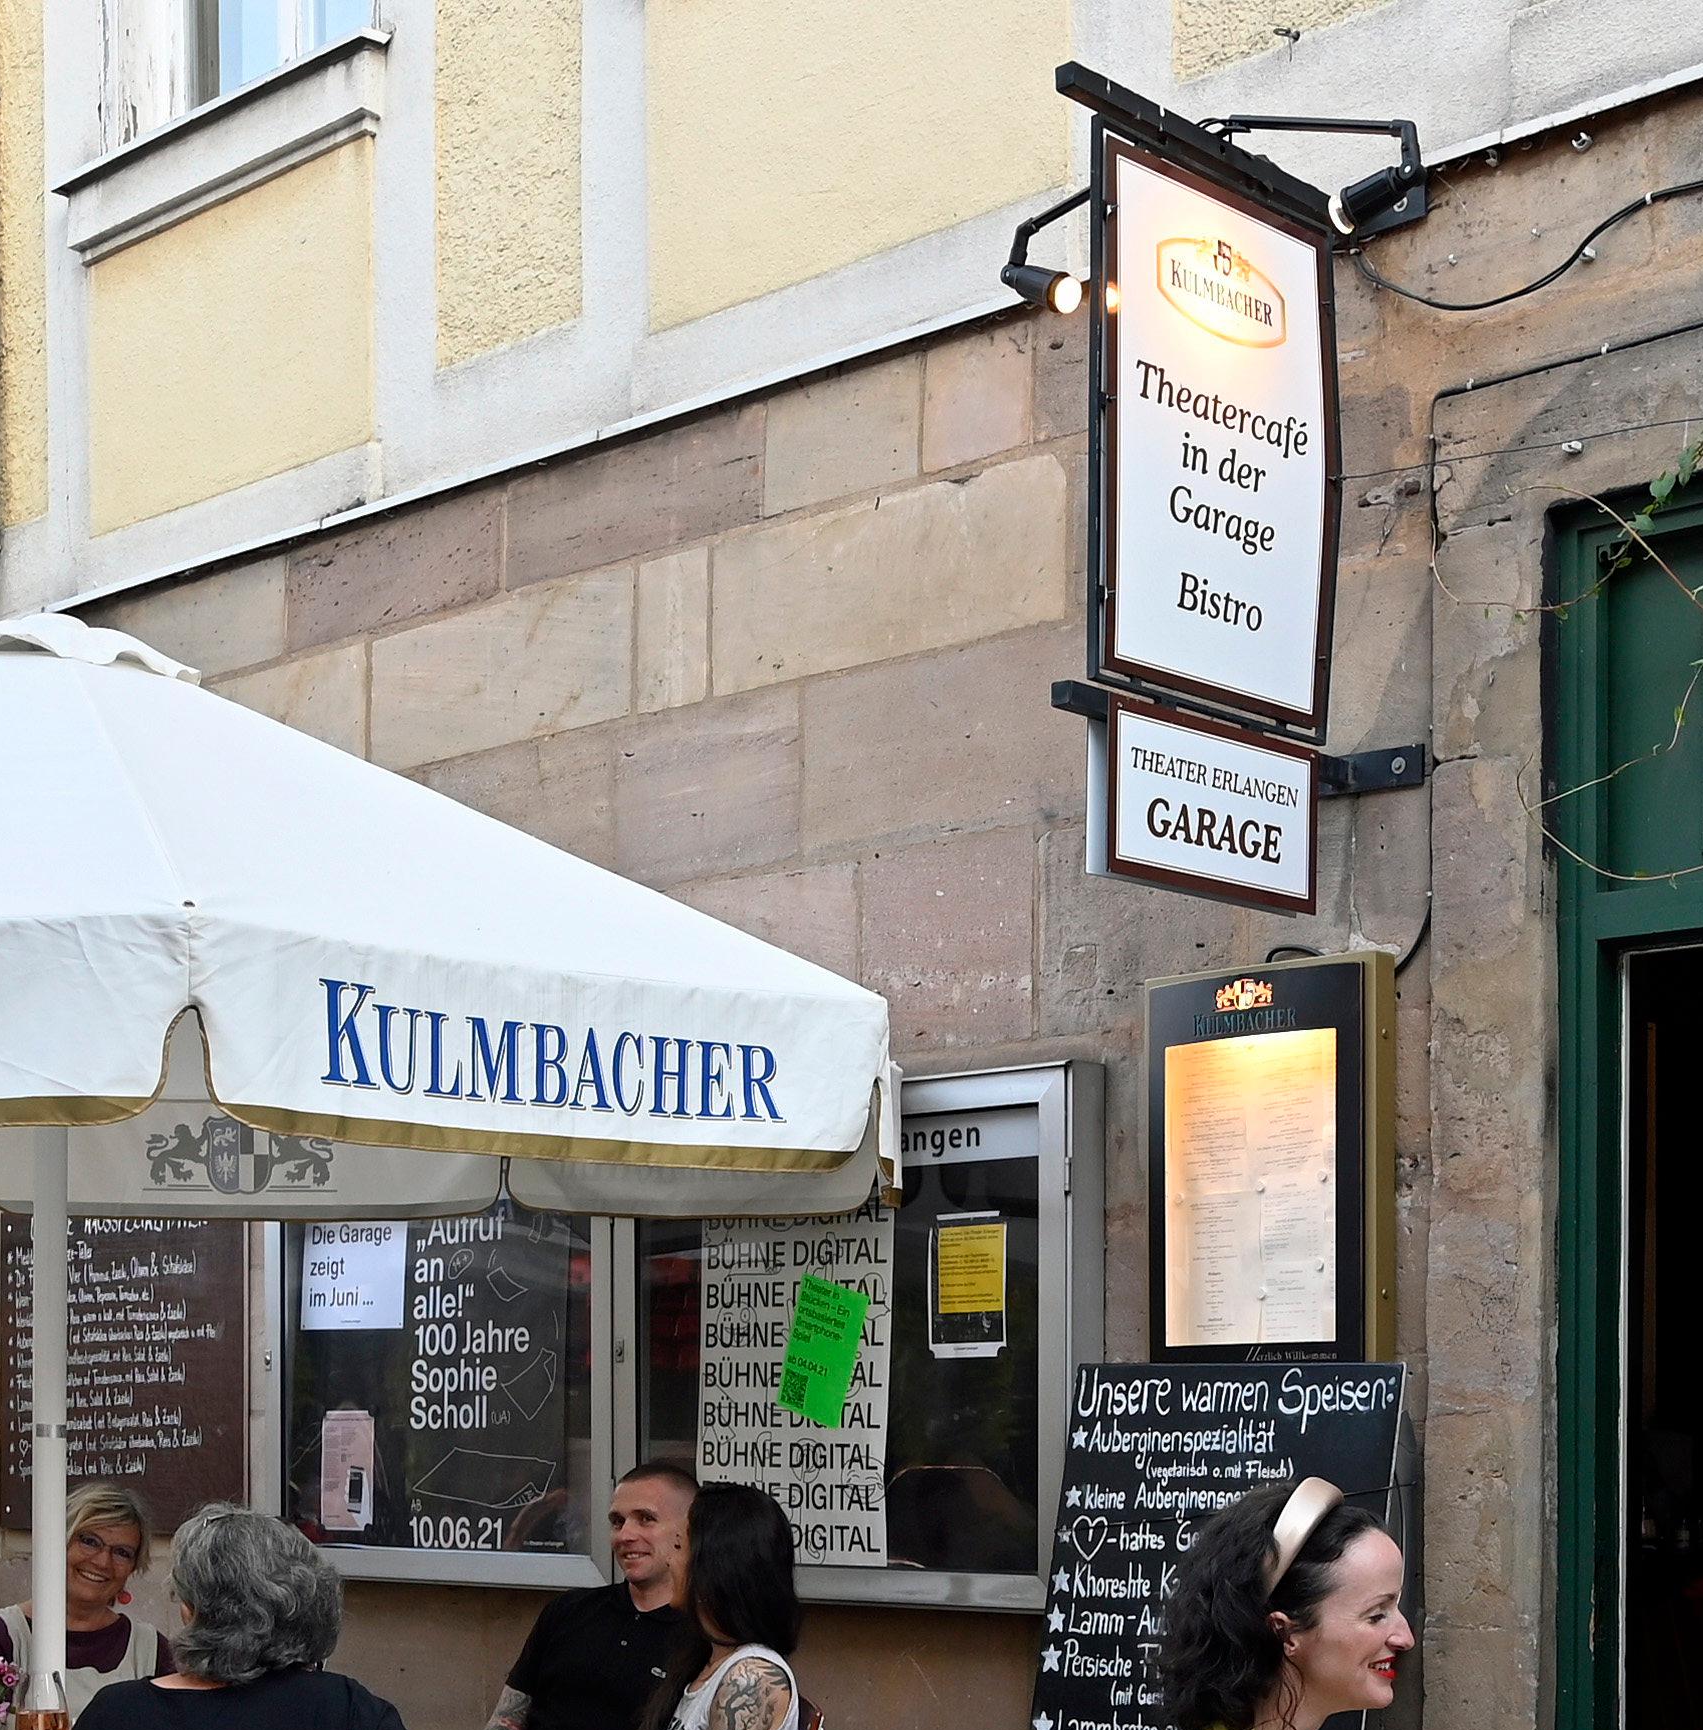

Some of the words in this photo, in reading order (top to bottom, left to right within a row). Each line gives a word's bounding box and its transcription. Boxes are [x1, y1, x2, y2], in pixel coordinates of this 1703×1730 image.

[1170, 259, 1273, 327] KULMBACHER
[1136, 360, 1308, 459] Theatercafé
[1182, 432, 1208, 474] in
[1218, 449, 1266, 492] der
[1170, 486, 1275, 555] Garage
[1177, 572, 1263, 631] Bistro
[1131, 747, 1207, 786] THEATER
[1212, 767, 1299, 808] ERLANGEN
[1147, 798, 1283, 864] GARAGE
[1194, 1008, 1297, 1037] KULMBACHER
[319, 978, 787, 1123] KULMBACHER
[900, 1126, 981, 1157] angen
[312, 1225, 335, 1245] Die
[339, 1224, 392, 1247] Garage
[310, 1256, 345, 1280] zeigt
[414, 1256, 444, 1284] an
[707, 1238, 786, 1270] BÜHNE
[793, 1237, 887, 1267] DIGITAL
[309, 1288, 326, 1308] im
[330, 1286, 359, 1307] Juni
[706, 1277, 785, 1309] BÜHNE
[414, 1322, 457, 1356] 100
[461, 1320, 530, 1354] Jahre
[705, 1316, 784, 1348] BÜHNE
[411, 1356, 498, 1398] Sophie
[704, 1356, 782, 1388] BÜHNE
[409, 1394, 487, 1430] Scholl
[703, 1396, 783, 1428] BÜHNE
[1077, 1367, 1172, 1417] Unsere
[1182, 1380, 1269, 1414] warmen
[1278, 1367, 1397, 1434] Speisen:
[702, 1435, 782, 1468] BÜHNE
[789, 1442, 878, 1470] DIGITAL
[1087, 1416, 1277, 1470] Auberginenspezialität
[1145, 1456, 1208, 1487] (vegetarisch
[1224, 1463, 1241, 1480] mit
[1245, 1456, 1294, 1481] Fleisch)
[788, 1483, 880, 1512] DIGITAL
[1084, 1484, 1127, 1510] kleine
[409, 1516, 505, 1550] 10.06.21
[1072, 1561, 1151, 1600] Khoreshte
[1063, 1638, 1132, 1678] Persische
